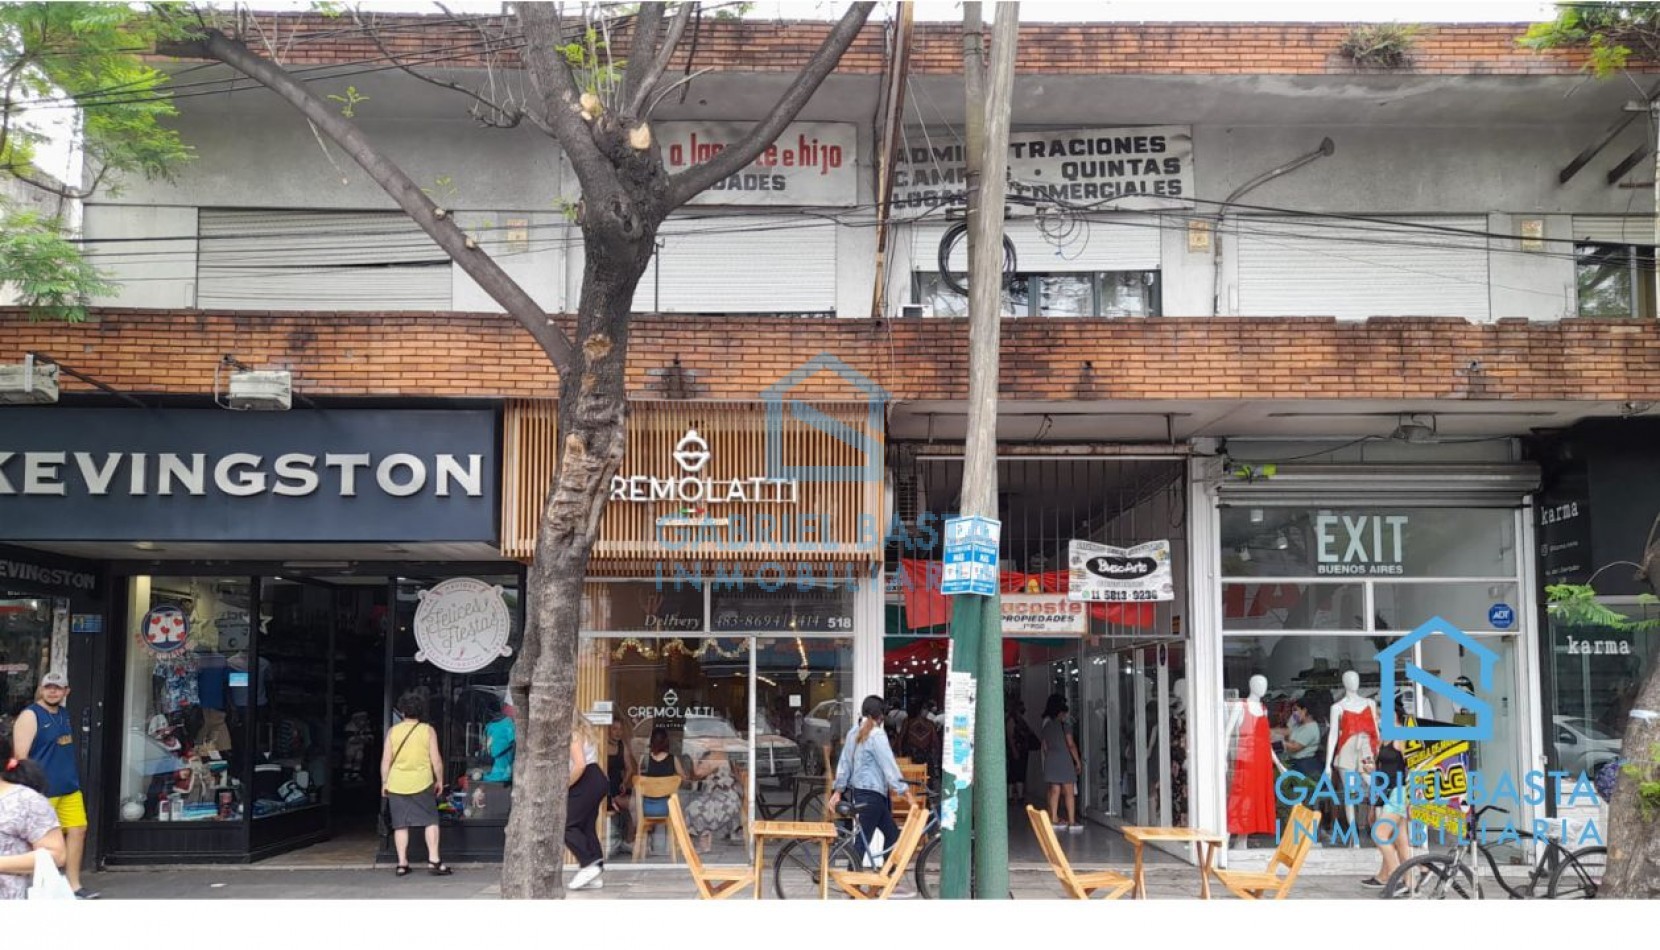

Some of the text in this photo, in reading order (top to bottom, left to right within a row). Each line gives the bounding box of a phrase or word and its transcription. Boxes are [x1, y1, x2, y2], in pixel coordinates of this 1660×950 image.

[782, 149, 794, 166] e
[799, 134, 842, 174] hijo
[896, 136, 1166, 163] ADMITRACIONES
[1061, 157, 1181, 181] QUINTAS
[610, 475, 797, 503] REMOLATTI
[1541, 502, 1579, 525] karma
[1317, 516, 1408, 562] EXIT
[0, 560, 96, 590] EVINGSTON
[1317, 565, 1404, 575] BUENOS AIRES
[1001, 599, 1082, 614] acoste
[828, 617, 852, 629] 518
[1567, 635, 1631, 655] karma
[628, 706, 715, 718] CREMOLATTI
